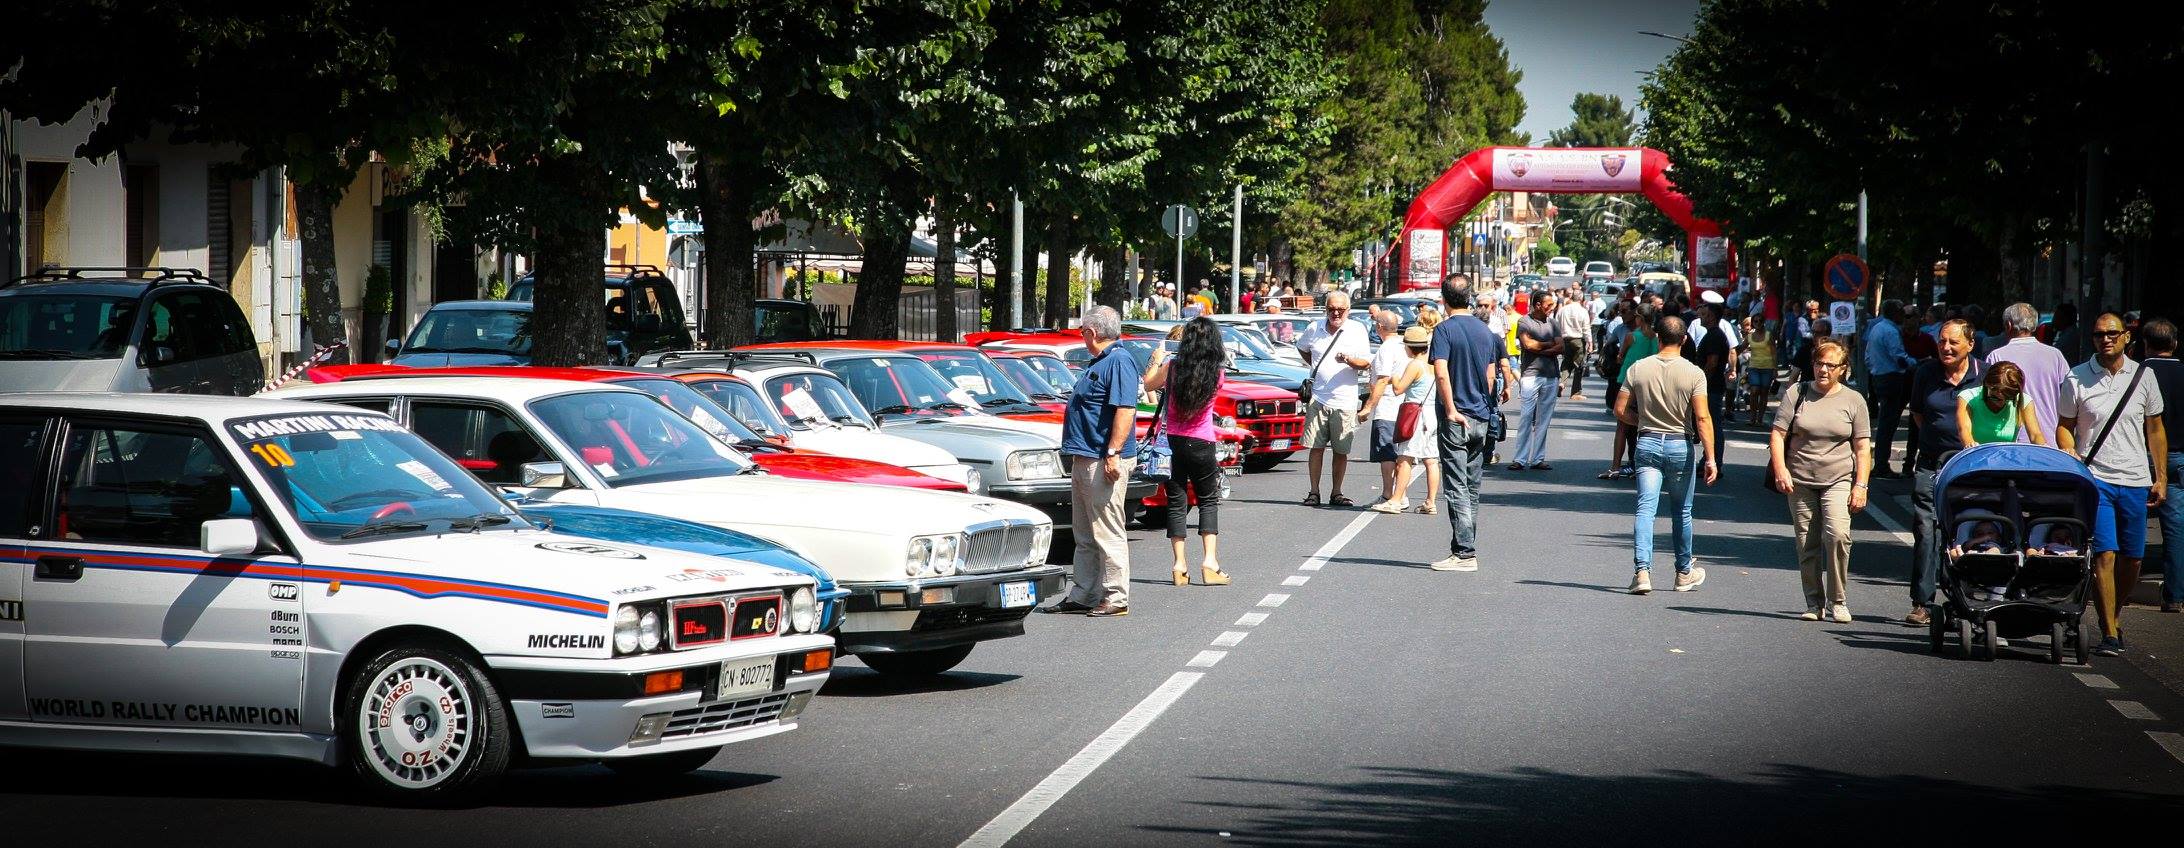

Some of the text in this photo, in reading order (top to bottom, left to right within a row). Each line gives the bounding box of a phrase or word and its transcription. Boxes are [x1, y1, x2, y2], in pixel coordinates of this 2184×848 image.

[233, 415, 409, 440] MARTINI RACING
[250, 442, 296, 468] 10
[271, 585, 297, 598] OMP
[269, 625, 300, 635] BOSCH
[528, 634, 605, 649] MICHELIN
[31, 698, 300, 726] WORLD RALLY CHAMPION
[379, 681, 414, 728] sparco
[543, 707, 574, 715] CHAMPION
[438, 718, 455, 752] Wheels
